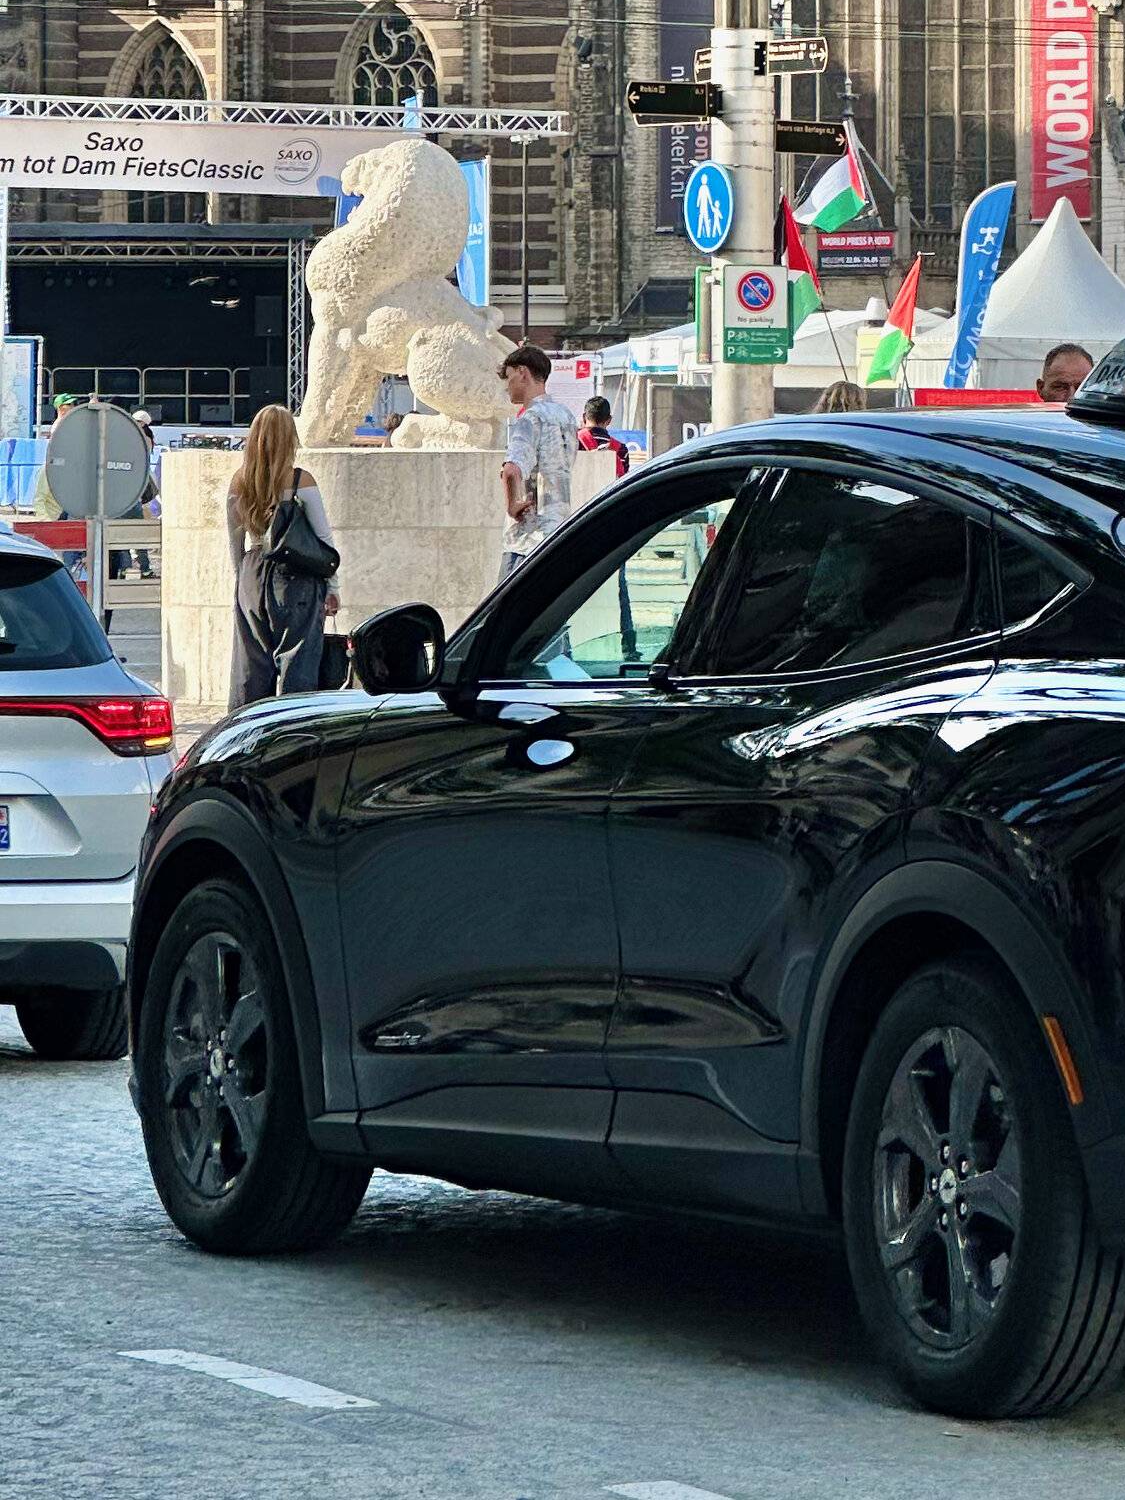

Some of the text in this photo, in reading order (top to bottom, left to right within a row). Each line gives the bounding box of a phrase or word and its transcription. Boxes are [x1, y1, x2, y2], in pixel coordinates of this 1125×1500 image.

[1045, 29, 1089, 188] WORLD
[670, 65, 690, 200] niekerk.nl
[84, 131, 144, 152] Saxo
[277, 149, 312, 160] SAXO
[23, 155, 56, 174] tot
[62, 155, 116, 176] Dam
[122, 157, 265, 180] FietsClassic
[821, 236, 846, 246] WORLD
[846, 236, 867, 246] PRESS
[748, 315, 774, 324] parking
[106, 461, 132, 470] BUKO
